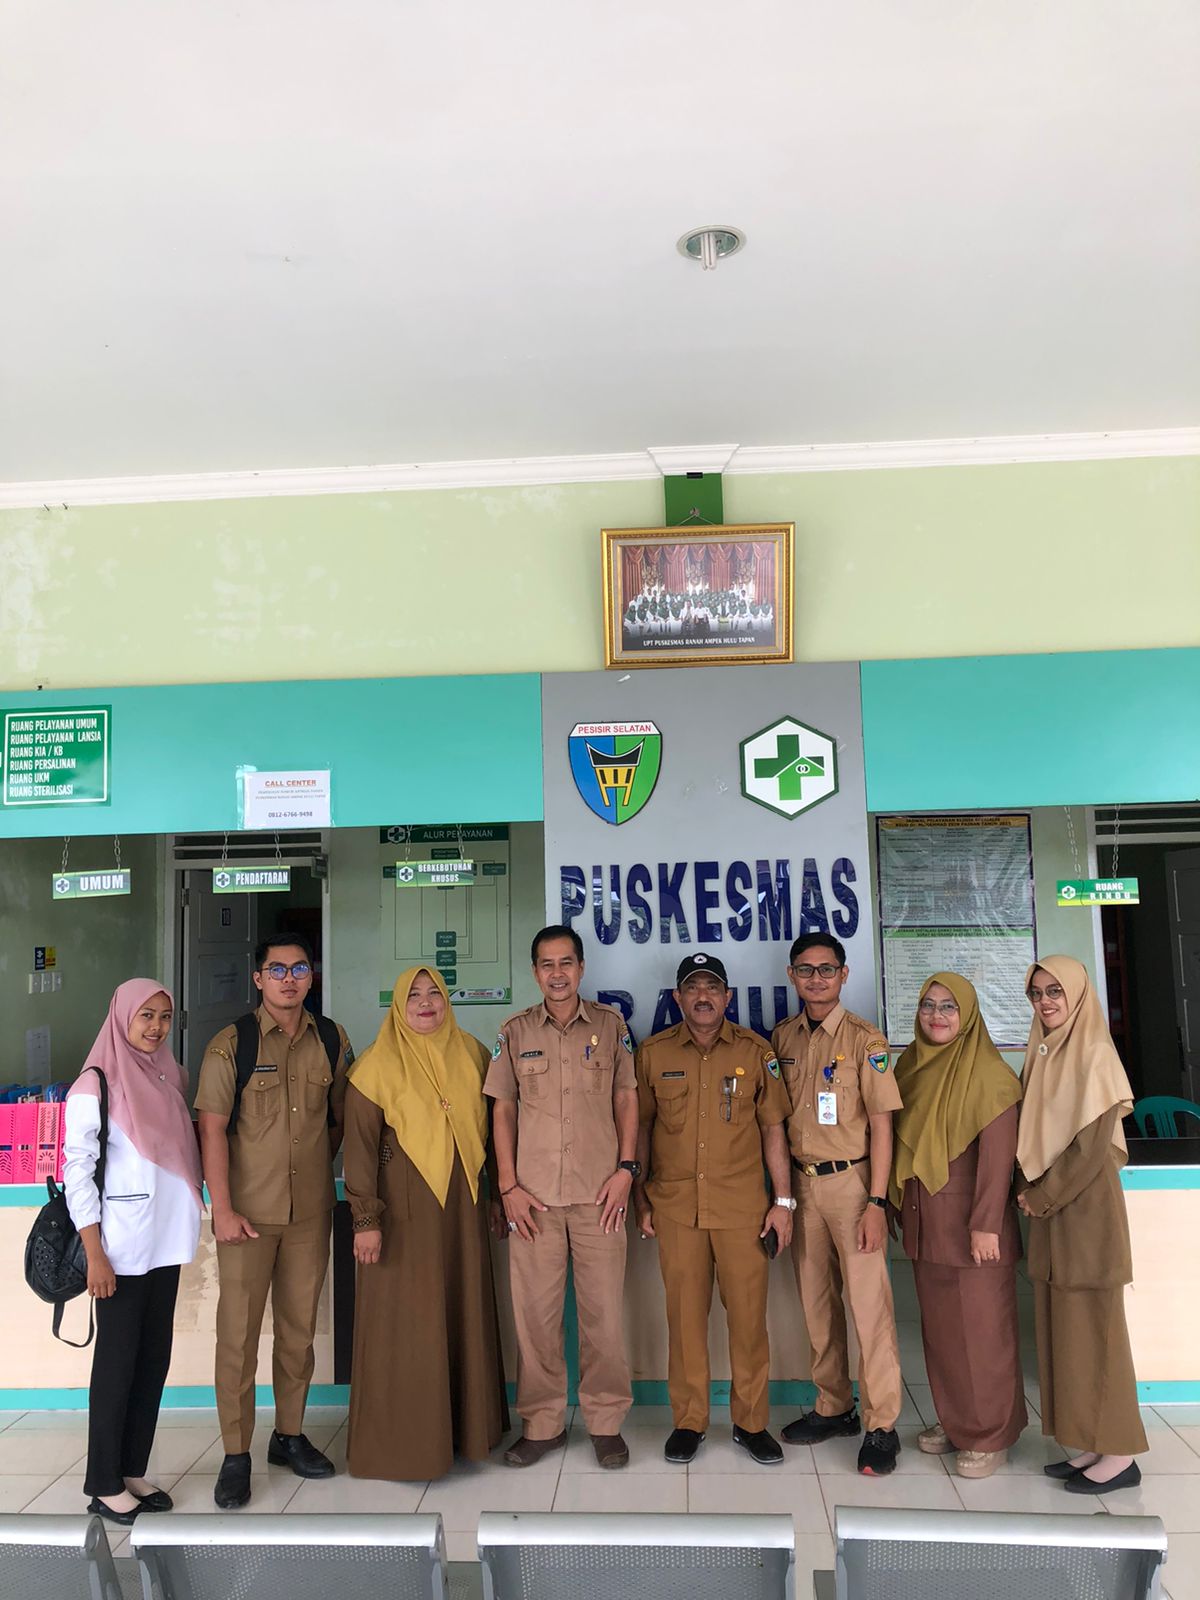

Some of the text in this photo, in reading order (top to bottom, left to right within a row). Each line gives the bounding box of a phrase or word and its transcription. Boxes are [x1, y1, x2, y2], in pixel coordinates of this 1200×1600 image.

[10, 718, 97, 732] RUANG PELAYANAN UMUM
[10, 731, 102, 744] RUANG PELAYANAN LANSIA
[10, 747, 33, 758] RUANG
[35, 746, 46, 757] KIA
[54, 745, 63, 756] KB
[10, 758, 76, 770] RUANG PERSALINAN
[10, 772, 50, 784] RUANG UKM
[10, 784, 73, 797] RUANG STERILISASI
[418, 863, 472, 872] BERKEBUTUHAN
[80, 875, 124, 890] UMUM
[235, 872, 288, 885] PENDAFTARAN
[431, 874, 459, 882] KHUSUS
[1096, 883, 1123, 891] RUANG
[560, 858, 860, 945] PUSKESMAS
